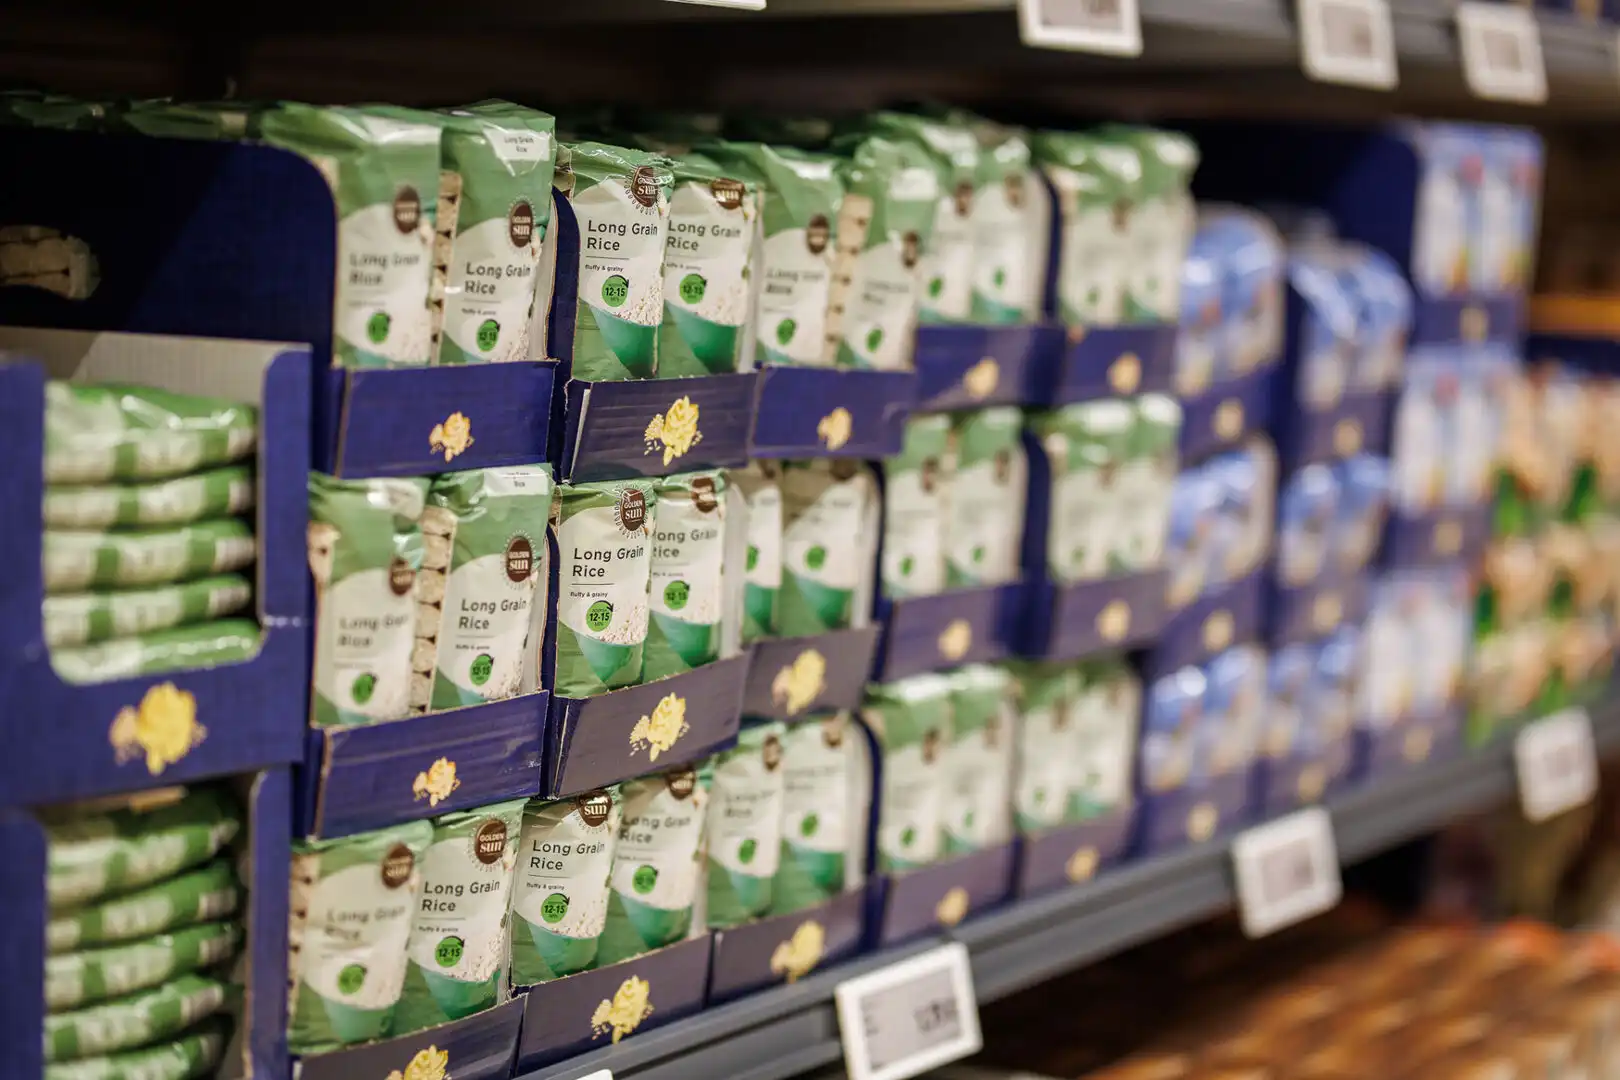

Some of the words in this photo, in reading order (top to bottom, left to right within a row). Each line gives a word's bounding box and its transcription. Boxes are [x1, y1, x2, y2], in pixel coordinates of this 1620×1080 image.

[588, 219, 627, 236] Long
[631, 223, 658, 236] Grain
[668, 220, 705, 237] Long
[711, 225, 742, 238] Grain
[586, 237, 620, 251] Rice
[667, 236, 699, 251] Rice
[466, 262, 502, 279] Long
[505, 264, 531, 277] Grain
[464, 280, 496, 295] Rice
[605, 287, 626, 297] 12-15
[623, 500, 644, 509] GOLDEN
[624, 509, 643, 520] sun
[574, 547, 612, 562] Long
[616, 546, 644, 560] Grain
[509, 559, 529, 570] sun
[572, 565, 605, 578] Rice
[461, 598, 496, 614] Long
[500, 599, 527, 612] Grain
[459, 616, 490, 630] Rice
[589, 612, 610, 622] 12-15
[584, 804, 607, 815] sun
[621, 815, 660, 830] Long
[480, 832, 504, 842] GOLDEN
[618, 828, 652, 842] Rice
[480, 841, 502, 853] sun
[533, 839, 571, 856] Long
[576, 841, 605, 855] Grain
[530, 856, 563, 870] Rice
[424, 881, 464, 897] Long
[469, 879, 500, 894] Grain
[422, 899, 456, 912] Rice
[544, 904, 565, 914] 12-15
[439, 948, 461, 957] 12-15
